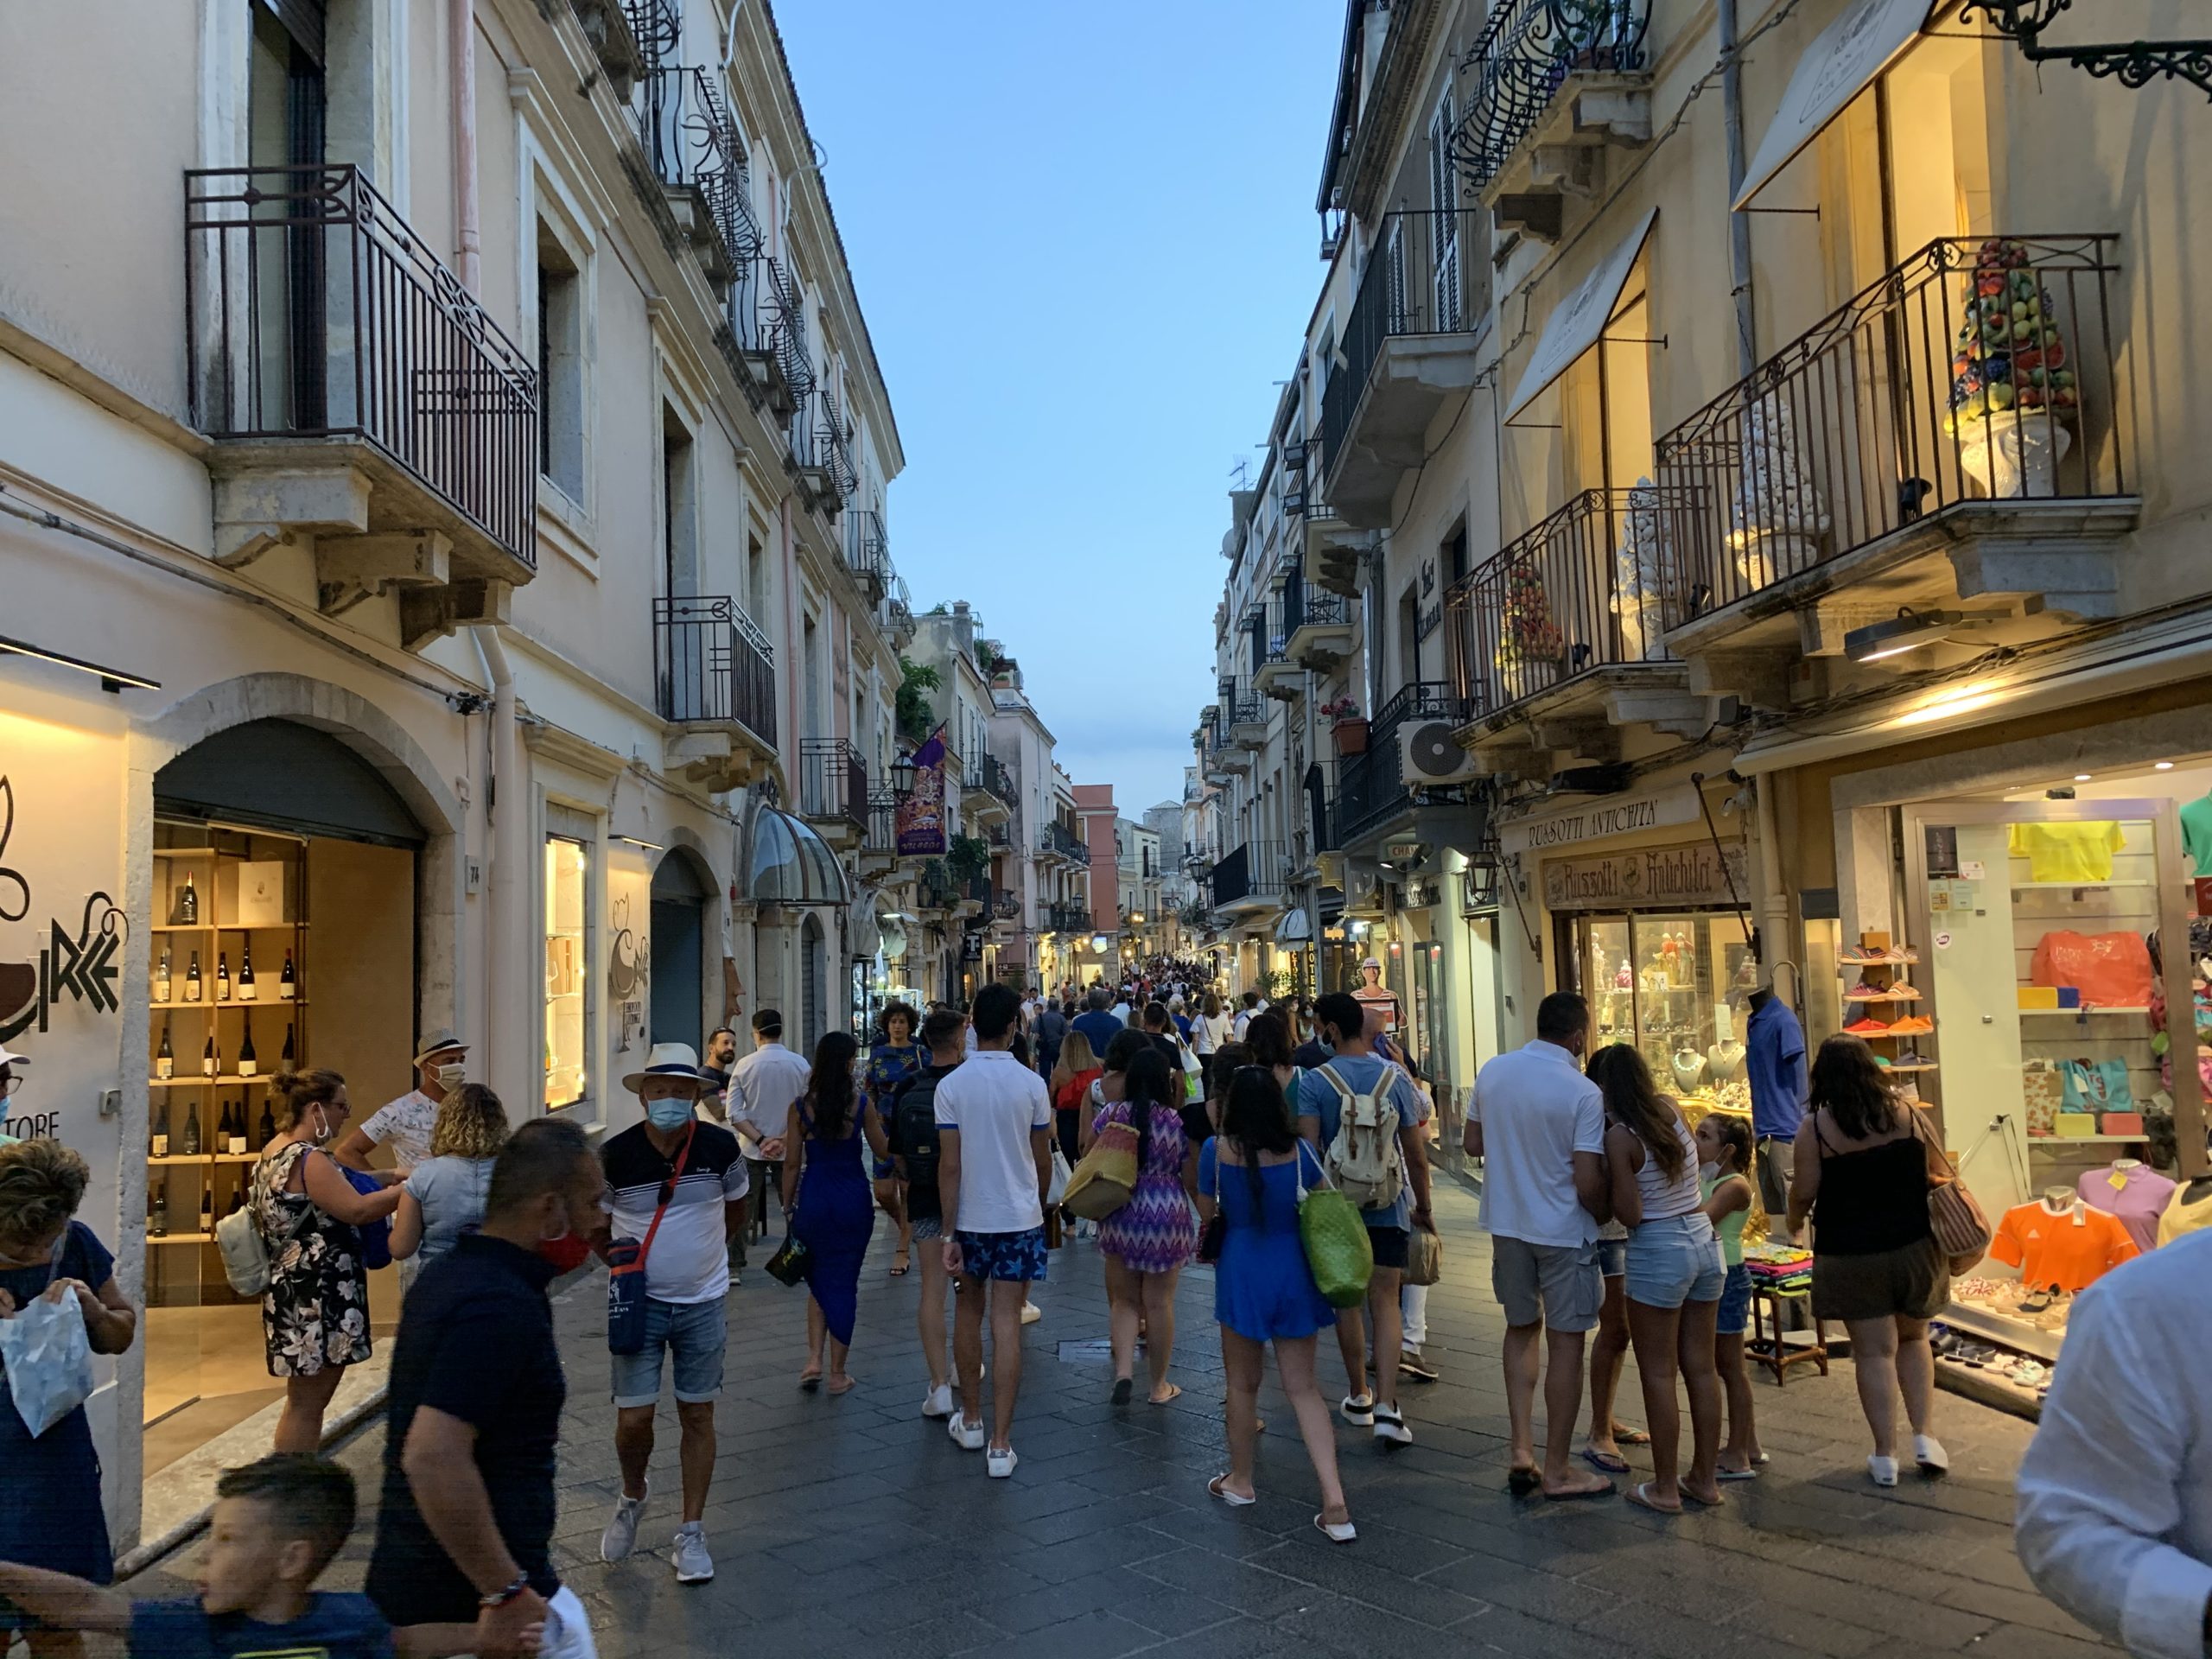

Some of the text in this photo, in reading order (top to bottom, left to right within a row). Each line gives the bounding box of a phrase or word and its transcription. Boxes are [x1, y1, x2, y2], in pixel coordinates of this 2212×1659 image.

[1529, 817, 1584, 847] RUSSOTTI
[1565, 861, 1618, 900] Russotti
[1308, 941, 1317, 997] HOTEL
